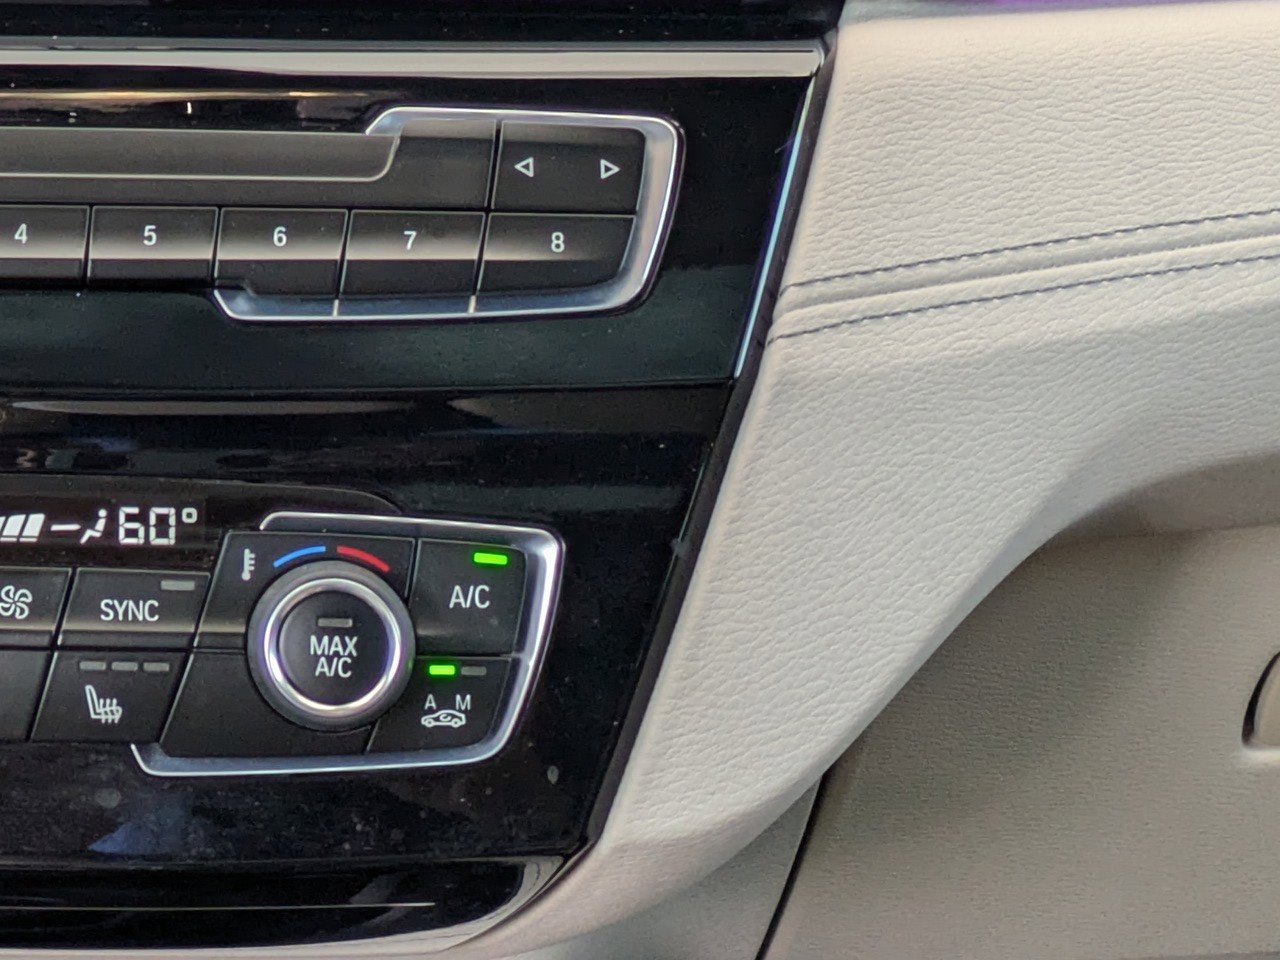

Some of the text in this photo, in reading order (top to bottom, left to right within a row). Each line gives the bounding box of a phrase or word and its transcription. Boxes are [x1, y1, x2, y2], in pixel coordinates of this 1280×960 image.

[14, 224, 28, 245] 4
[143, 225, 157, 247] 5
[273, 227, 287, 248] 6
[403, 231, 417, 251] 7
[550, 232, 565, 253] 8
[450, 585, 489, 609] A/C
[101, 599, 158, 622] SYNC
[310, 635, 357, 657] MAX
[315, 656, 352, 678] A/C
[424, 694, 436, 710] A
[455, 694, 470, 710] M
